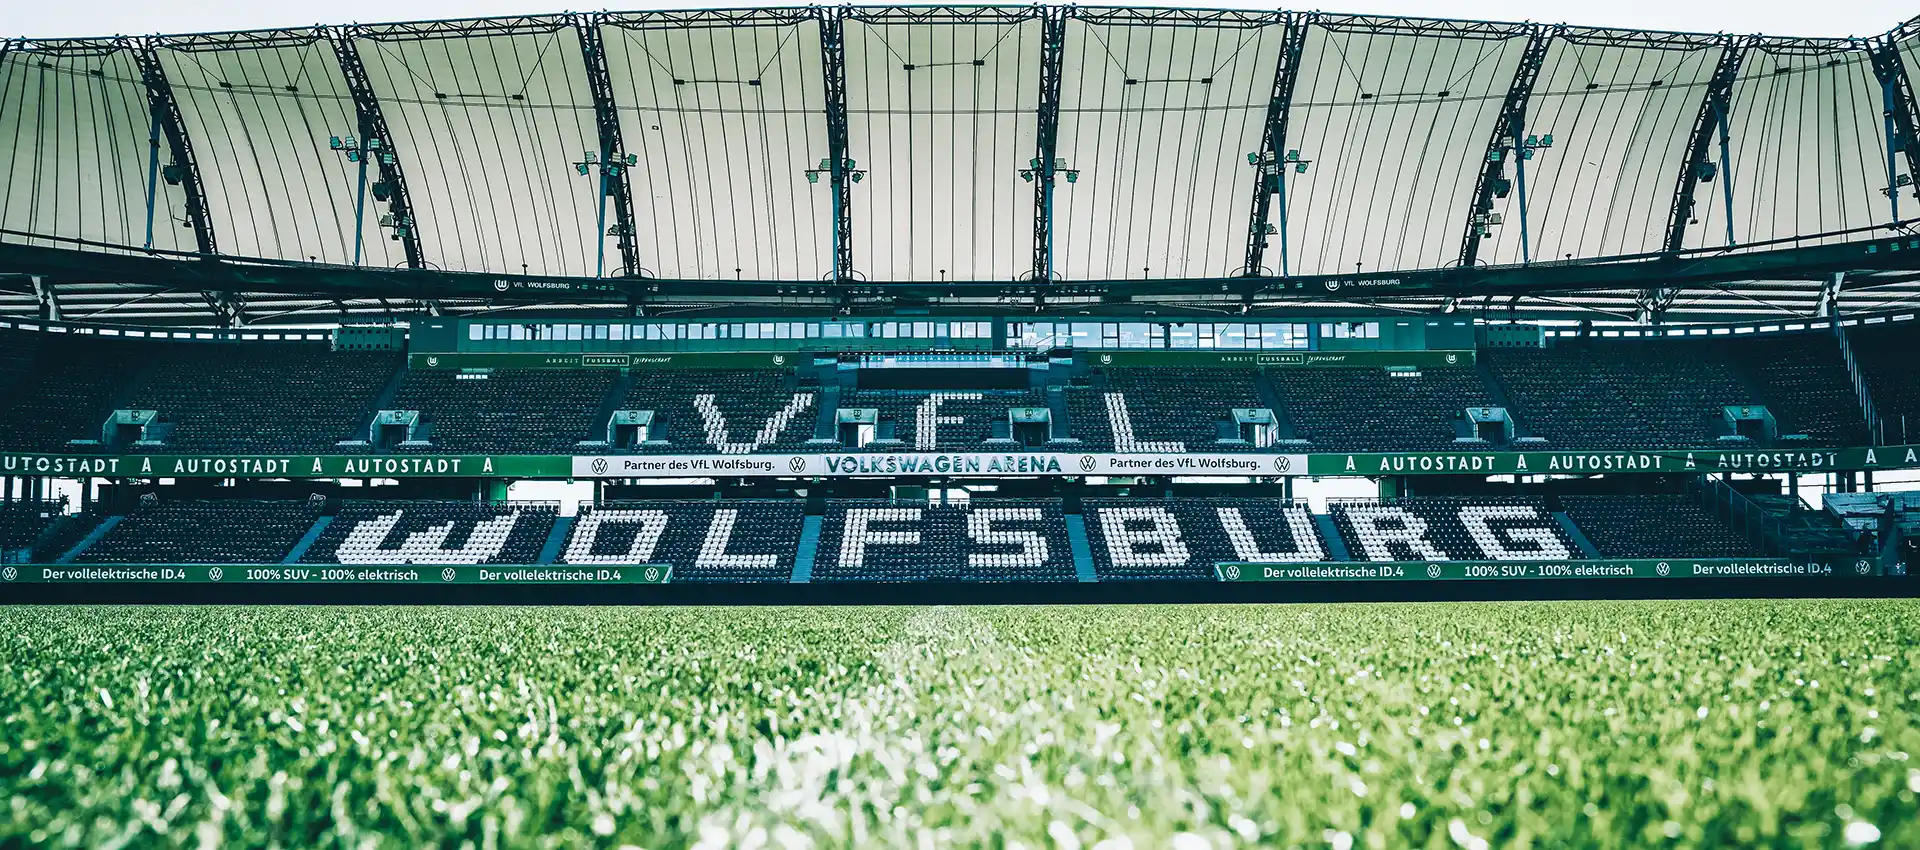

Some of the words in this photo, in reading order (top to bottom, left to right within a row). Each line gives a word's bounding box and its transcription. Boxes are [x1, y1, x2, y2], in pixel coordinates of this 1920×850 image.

[527, 281, 570, 290] WOLFSBURG
[1358, 278, 1401, 287] WOLFSBURG
[174, 459, 289, 473] AUTOSTADT
[345, 459, 461, 472] AUTOSTADT
[624, 460, 667, 470] Partner
[668, 459, 689, 470] des
[690, 459, 710, 470] VfL
[711, 459, 775, 472] Wolfsburg.
[824, 456, 981, 474] VOLKSWAGEN
[986, 455, 1063, 473] ARENA
[1110, 458, 1153, 468] Partner
[1154, 458, 1175, 468] des
[1176, 457, 1197, 468] VfL
[1198, 458, 1261, 471] Wolfsburg.
[1380, 457, 1495, 470] AUTOSTADT
[1550, 455, 1661, 469] AUTOSTADT
[1717, 452, 1838, 468] AUTOSTADT
[336, 504, 1571, 567] WOLFSBURG
[43, 569, 64, 578] Der
[68, 568, 157, 579] vollelektrische
[162, 569, 185, 579] ID.4
[247, 569, 280, 579] 100%
[284, 569, 309, 579] SUV
[321, 570, 354, 580] 100%
[358, 570, 418, 580] elektrisch
[480, 570, 501, 580] Der
[504, 570, 593, 580] vollelektrische
[597, 570, 621, 580] ID.4
[1264, 568, 1285, 577] Der
[1287, 567, 1376, 577] vollelektrische
[1380, 566, 1404, 576] ID.4
[1465, 566, 1498, 576] 100%
[1502, 566, 1526, 576] SUV
[1539, 565, 1571, 575] 100%
[1575, 565, 1633, 575] elektrisch
[1693, 564, 1714, 574] Der
[1716, 562, 1805, 576] vollelektrische
[1807, 562, 1833, 575] ID.4
